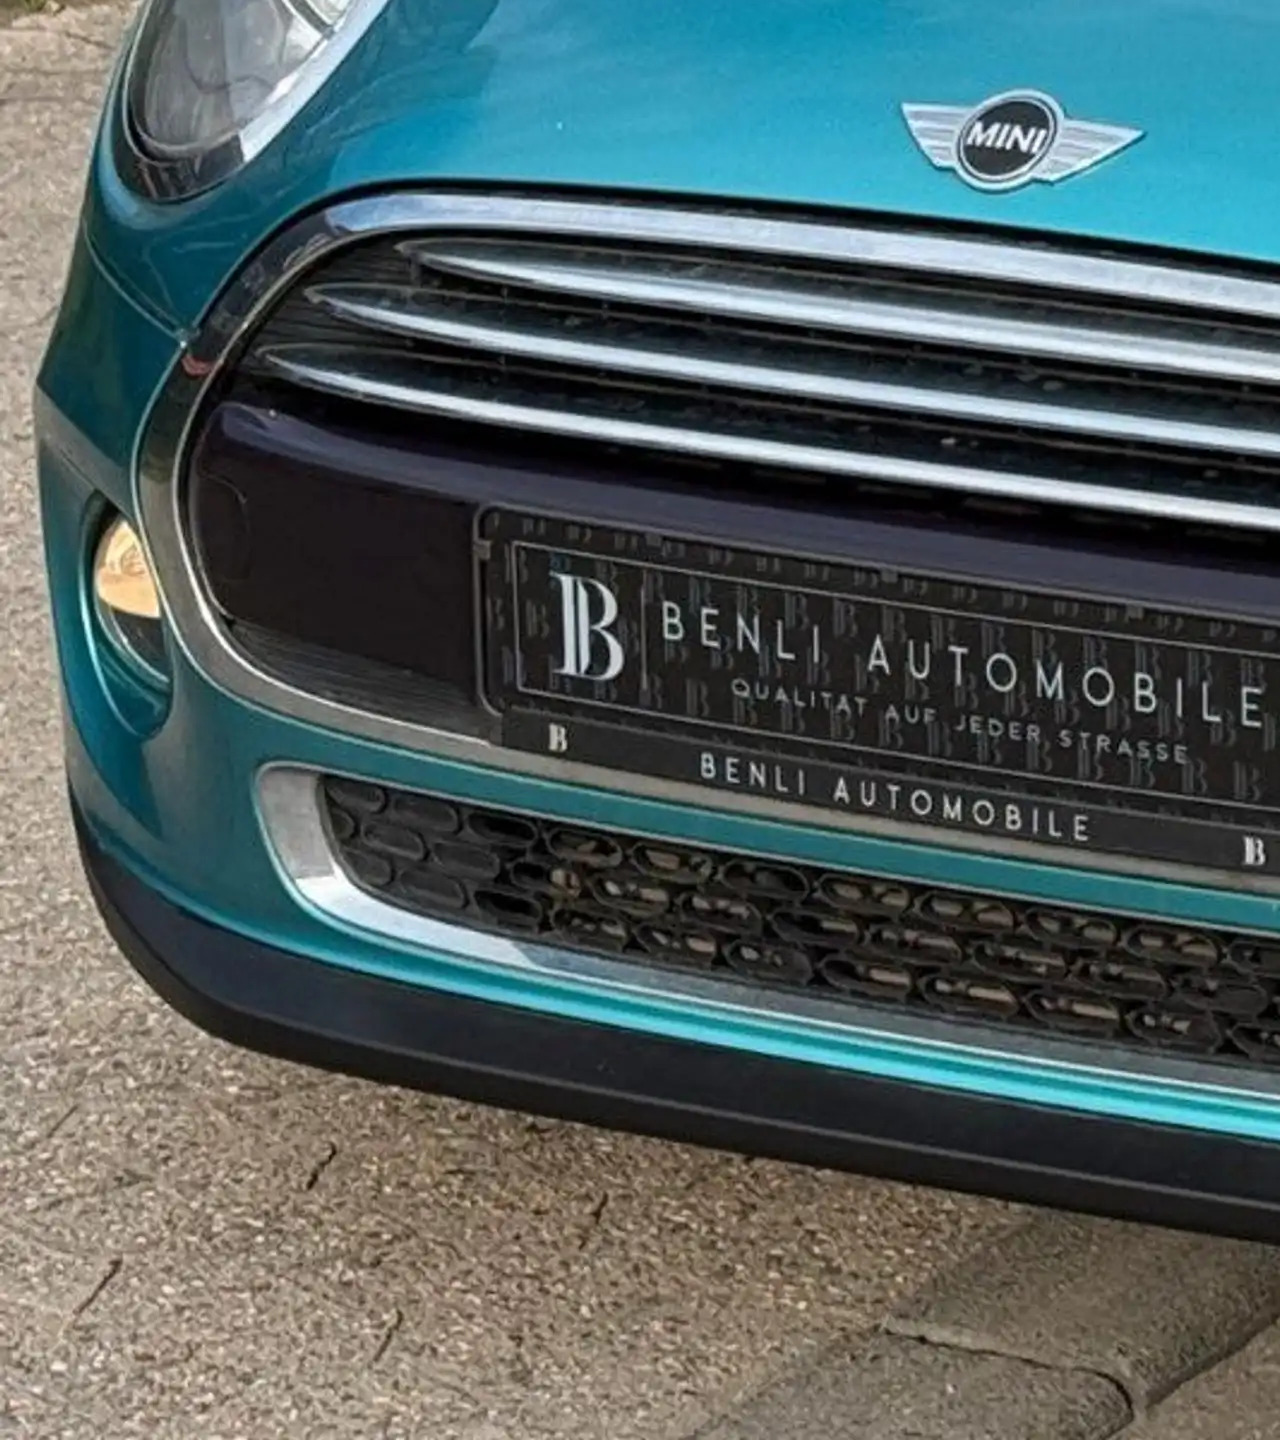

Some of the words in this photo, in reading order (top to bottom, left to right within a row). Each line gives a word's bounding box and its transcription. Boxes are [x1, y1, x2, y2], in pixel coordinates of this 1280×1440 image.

[966, 121, 1047, 153] MINI
[661, 599, 823, 664] BENLI
[866, 633, 1264, 729] AUTOMOBILE
[884, 703, 937, 726] AUF
[955, 713, 1041, 743] JEDER
[1058, 728, 1189, 766] STRASSE
[700, 752, 805, 796] BENLI
[832, 776, 1090, 842] AUTOMOBILE
